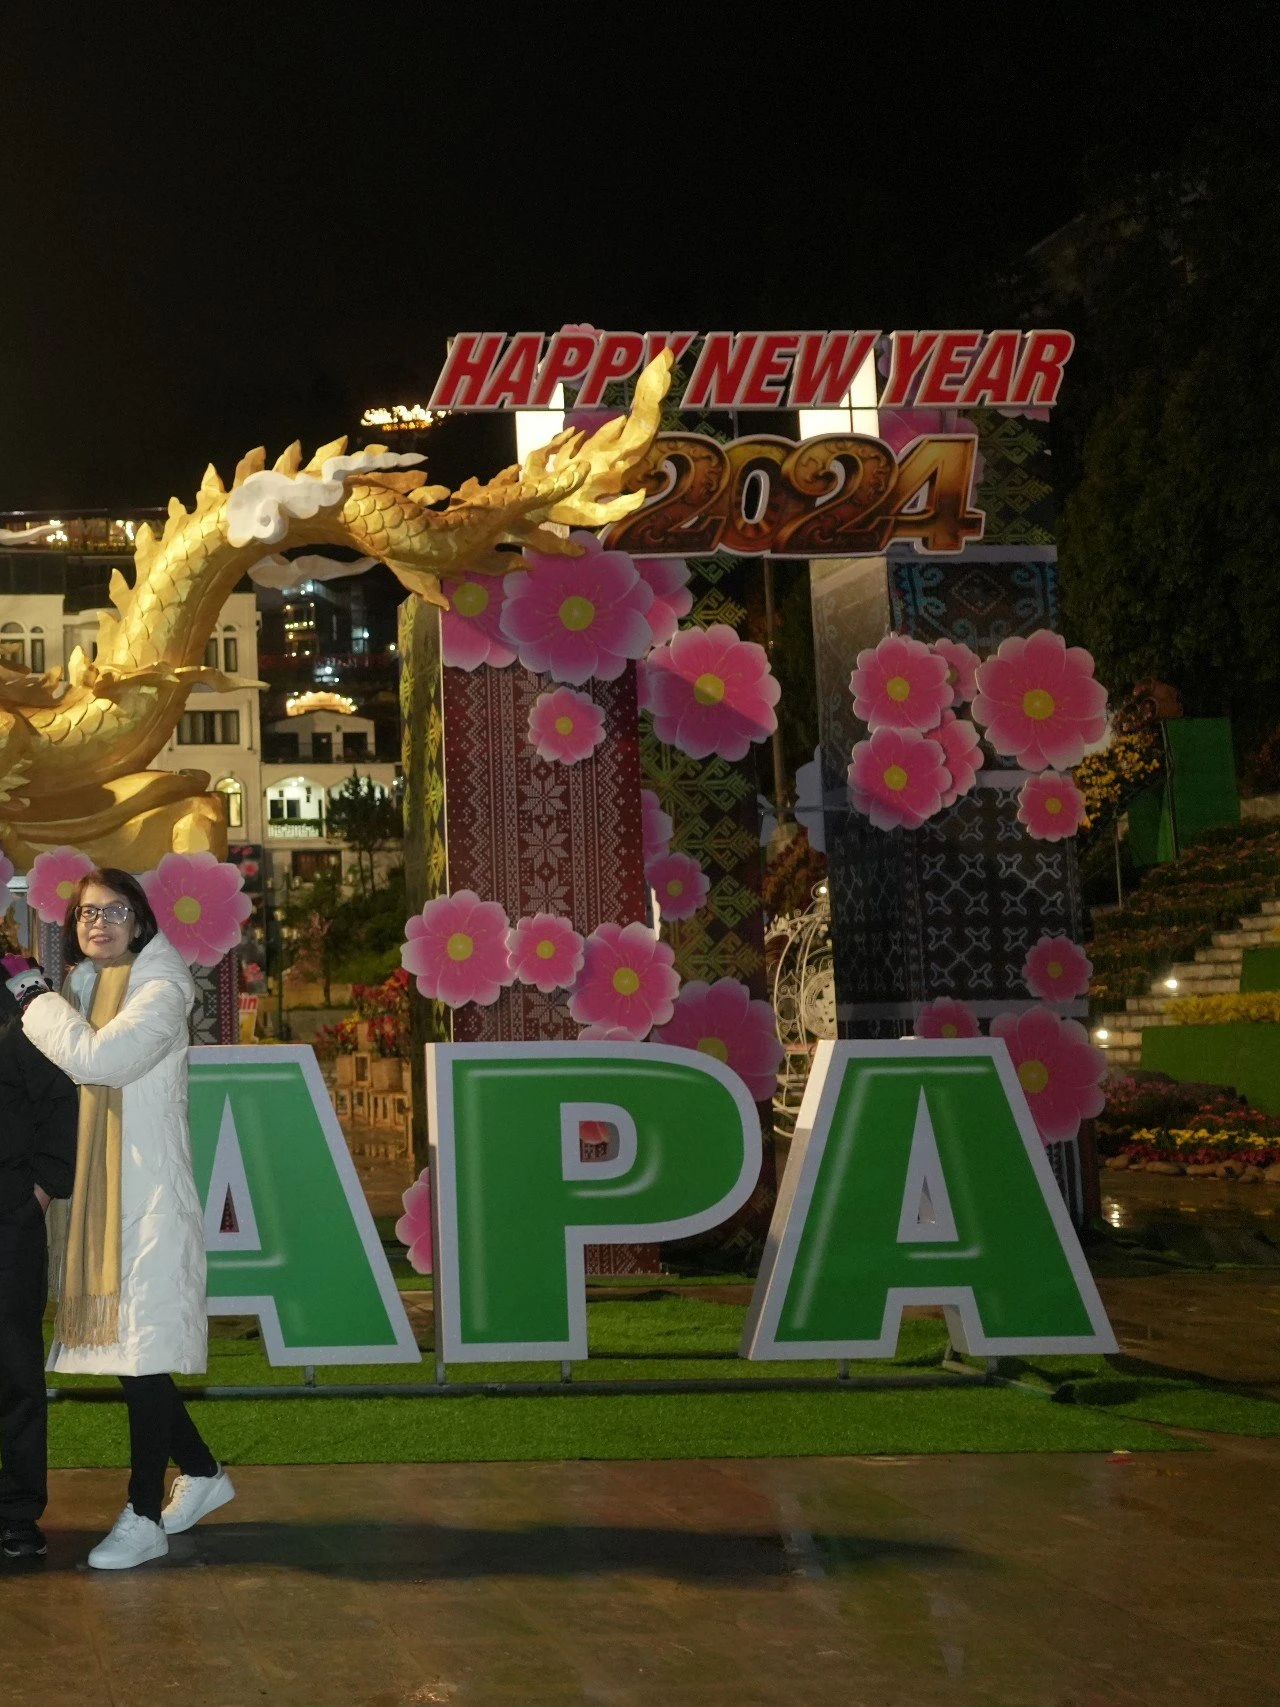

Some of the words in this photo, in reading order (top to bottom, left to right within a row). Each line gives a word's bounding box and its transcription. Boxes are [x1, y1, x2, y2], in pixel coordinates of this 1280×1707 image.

[679, 330, 882, 408] NEW
[877, 328, 1075, 408] YEAR
[601, 431, 987, 559] 2024
